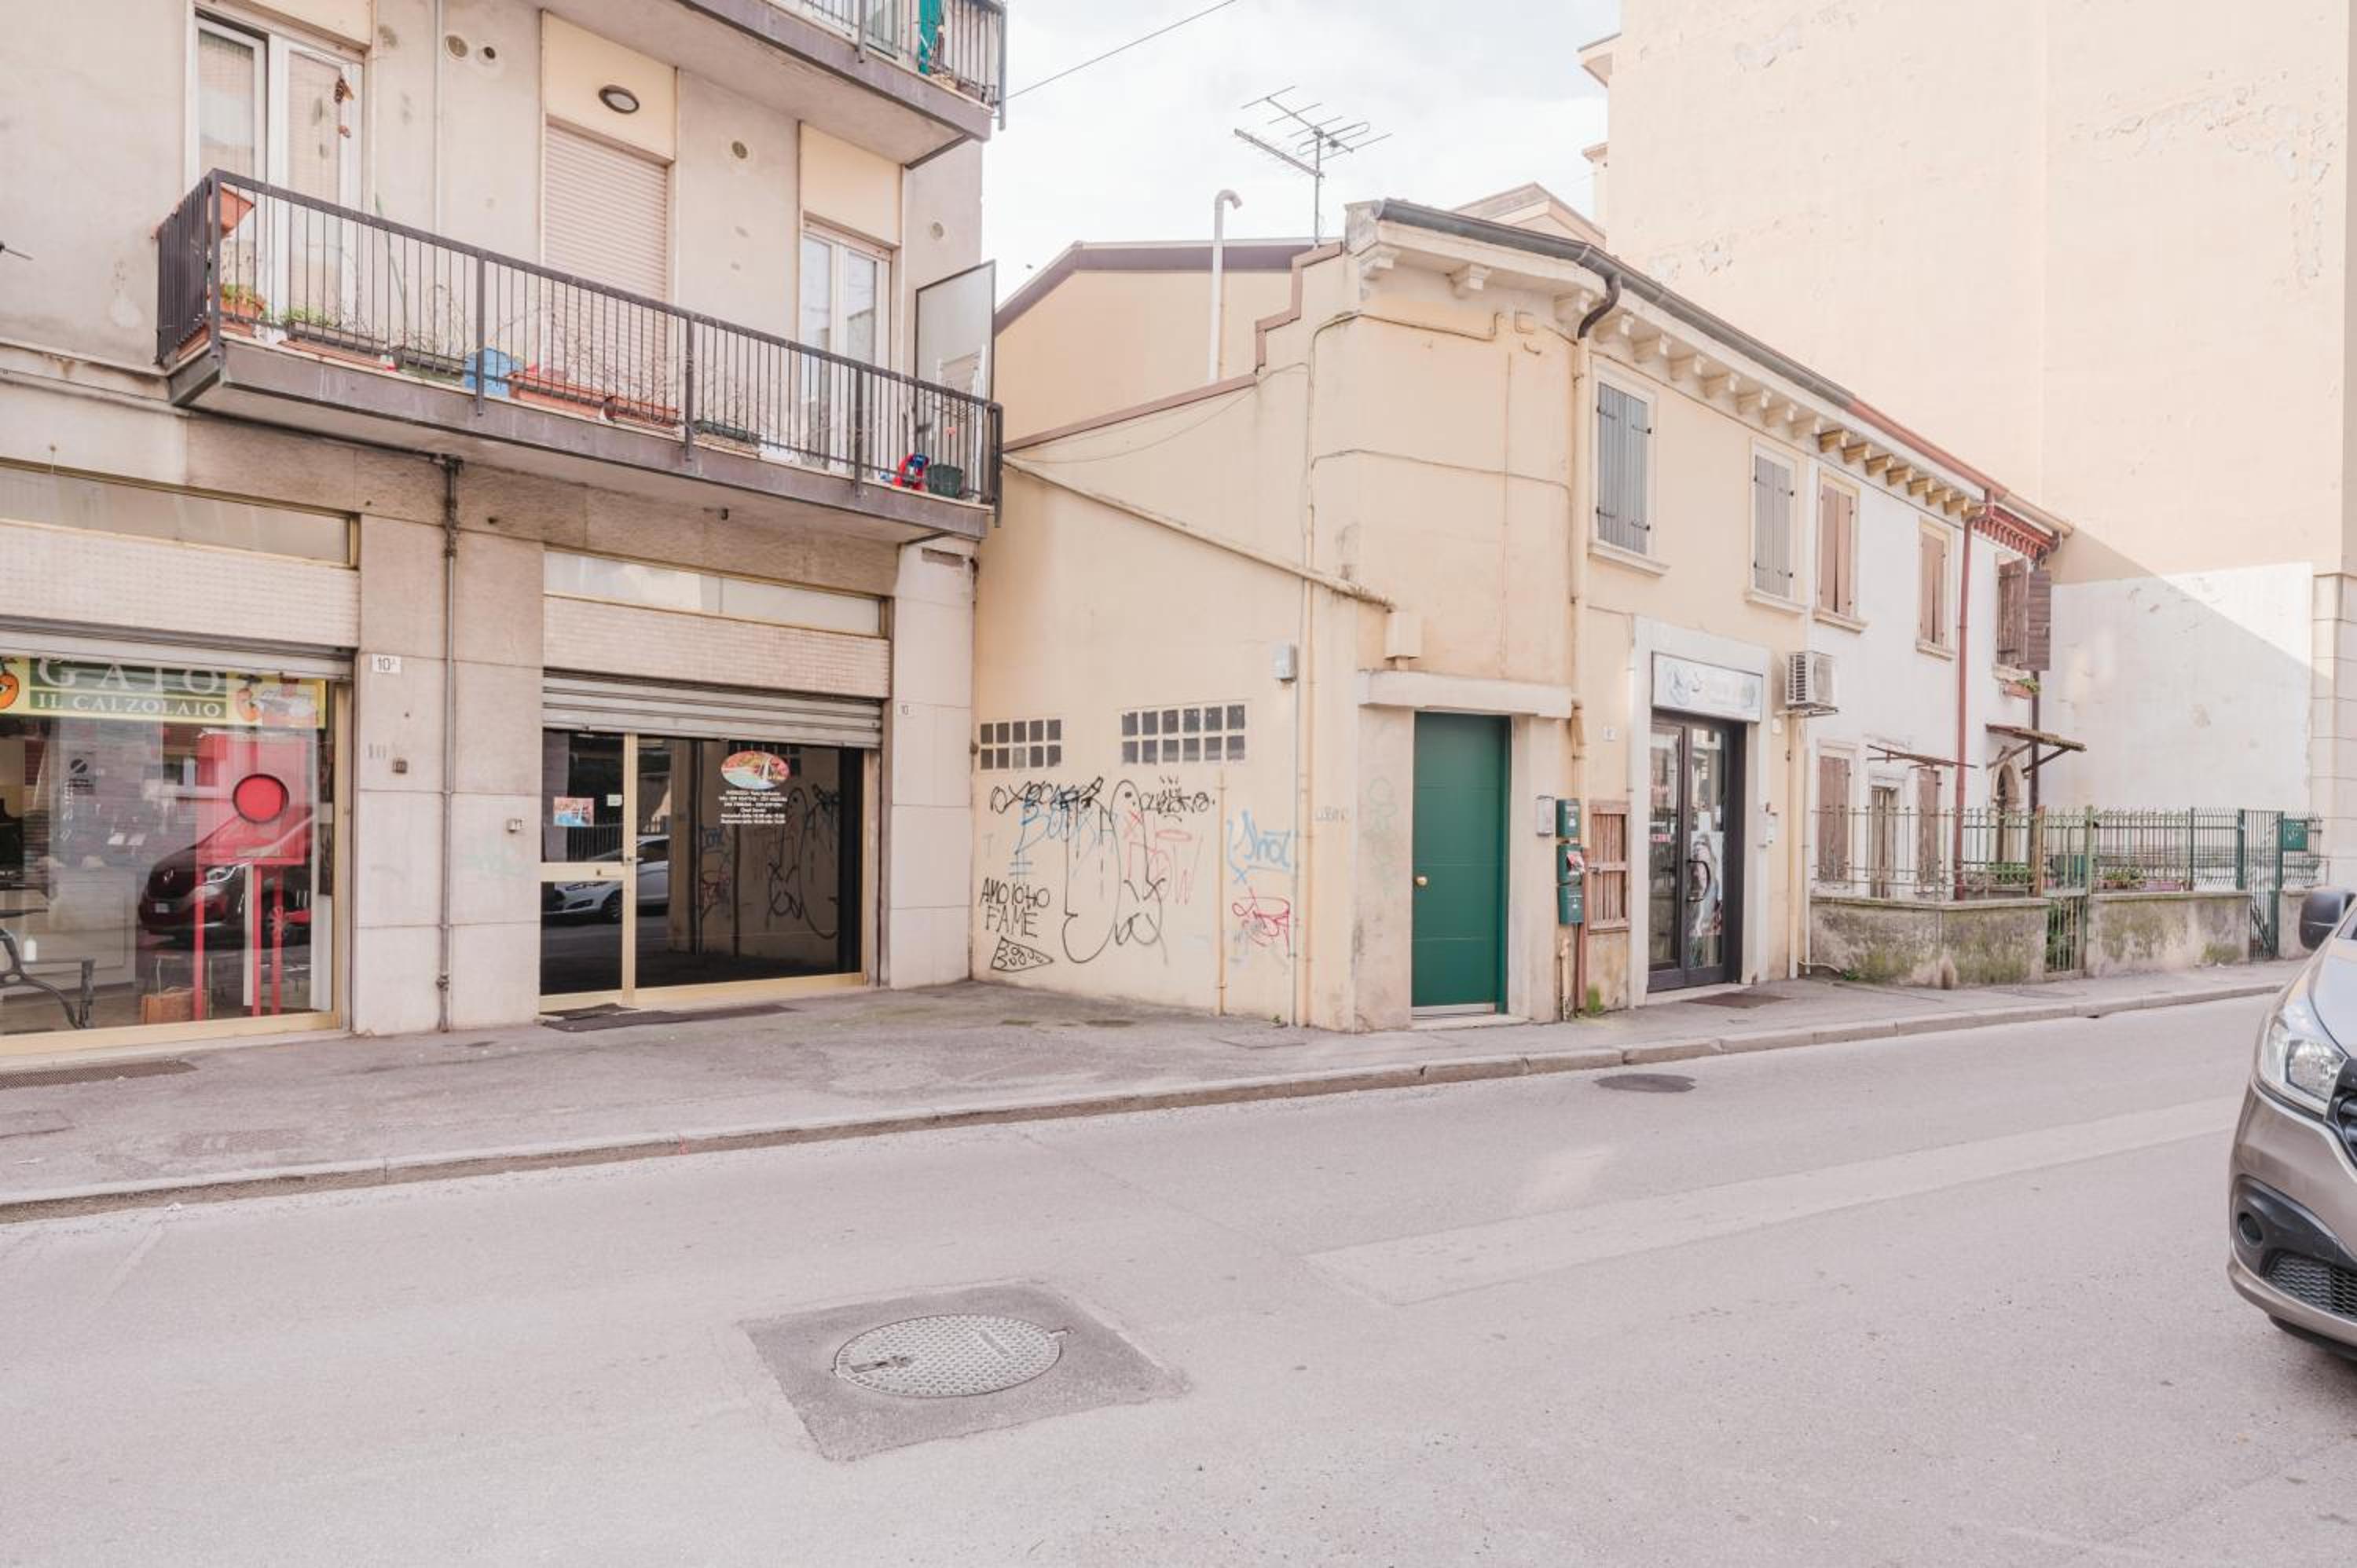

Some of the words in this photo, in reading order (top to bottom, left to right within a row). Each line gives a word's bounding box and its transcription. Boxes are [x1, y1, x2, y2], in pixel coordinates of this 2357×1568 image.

[38, 658, 221, 694] GAIO
[38, 694, 63, 709] IL
[72, 695, 222, 717] CALZOLAIO
[985, 904, 1039, 938] FAME
